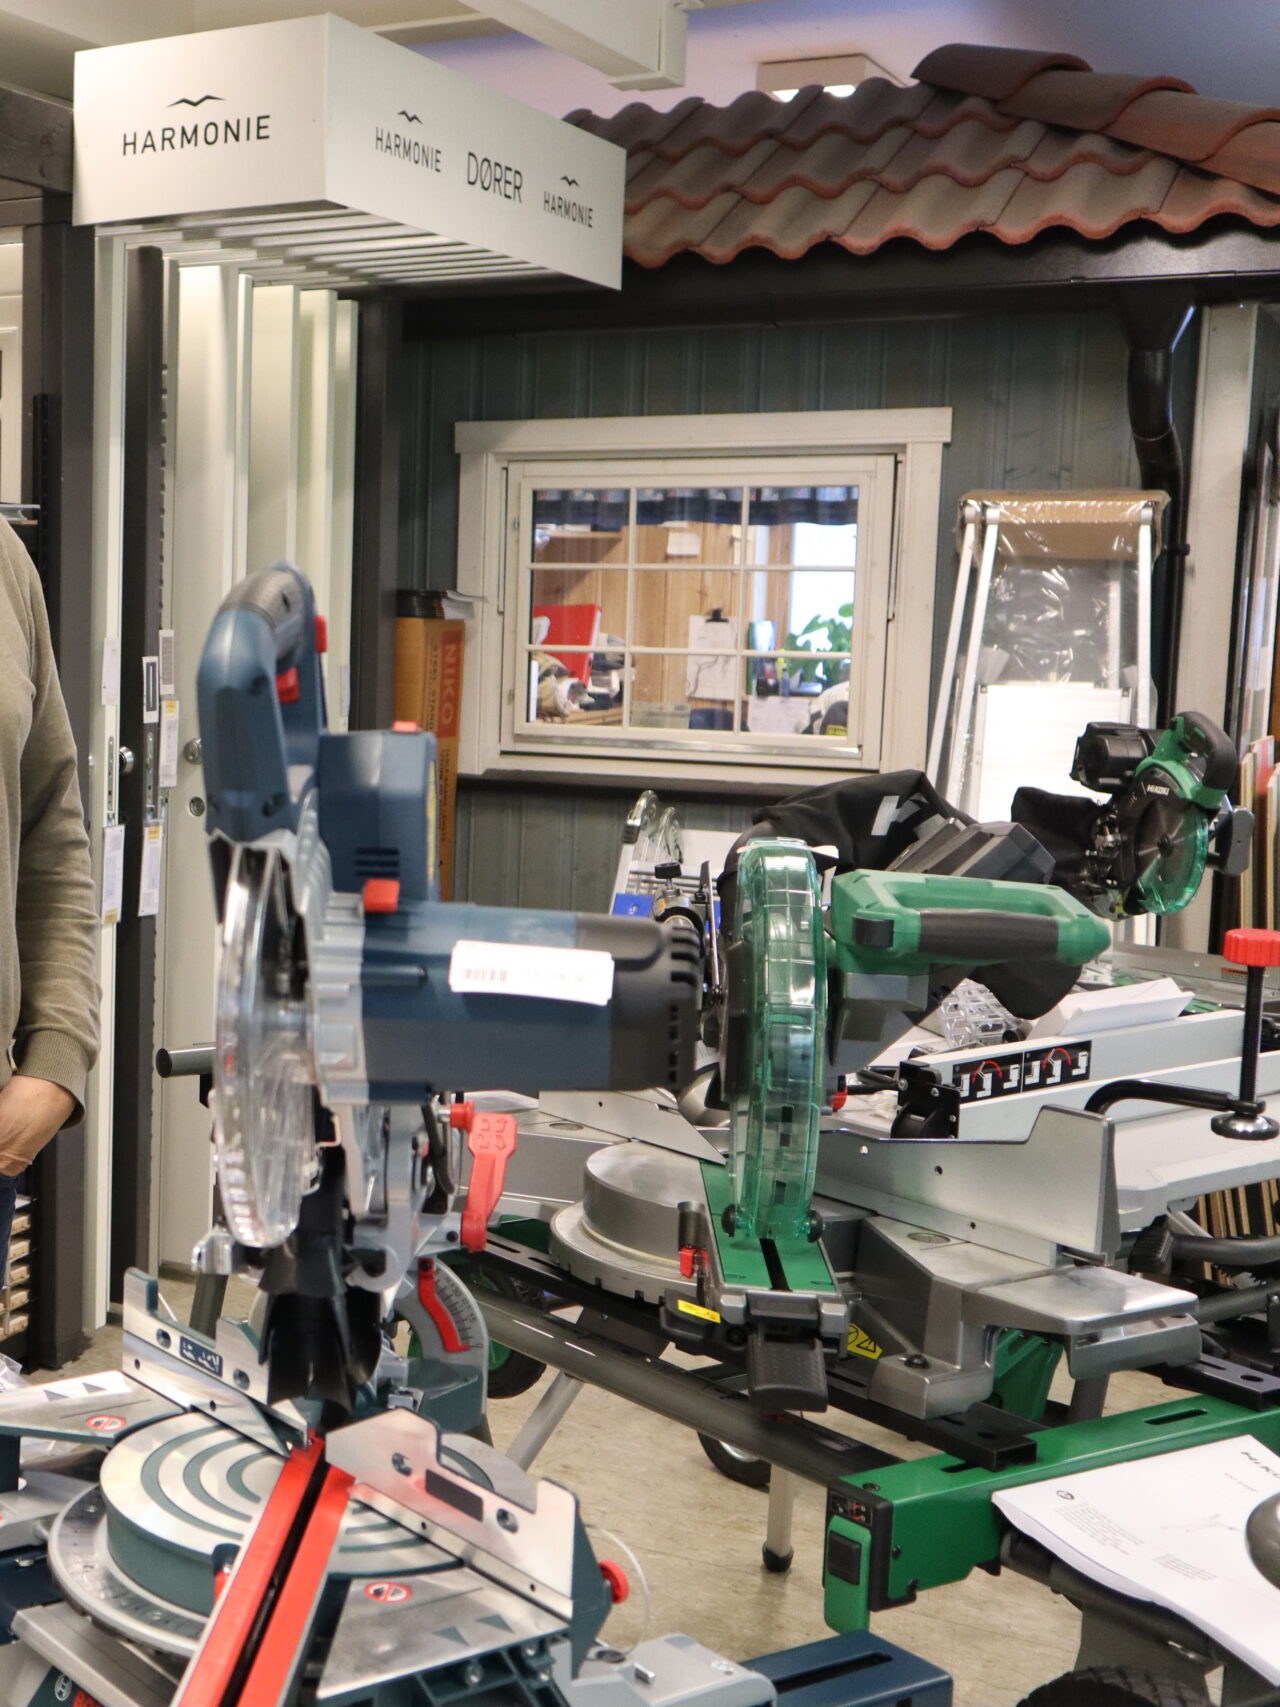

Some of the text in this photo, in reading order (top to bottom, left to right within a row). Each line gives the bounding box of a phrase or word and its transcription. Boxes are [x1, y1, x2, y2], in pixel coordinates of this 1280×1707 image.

[122, 115, 271, 156] HARMONIE
[375, 127, 594, 229] HARMONIE DØRER HARMONIE
[441, 644, 457, 725] NIKO
